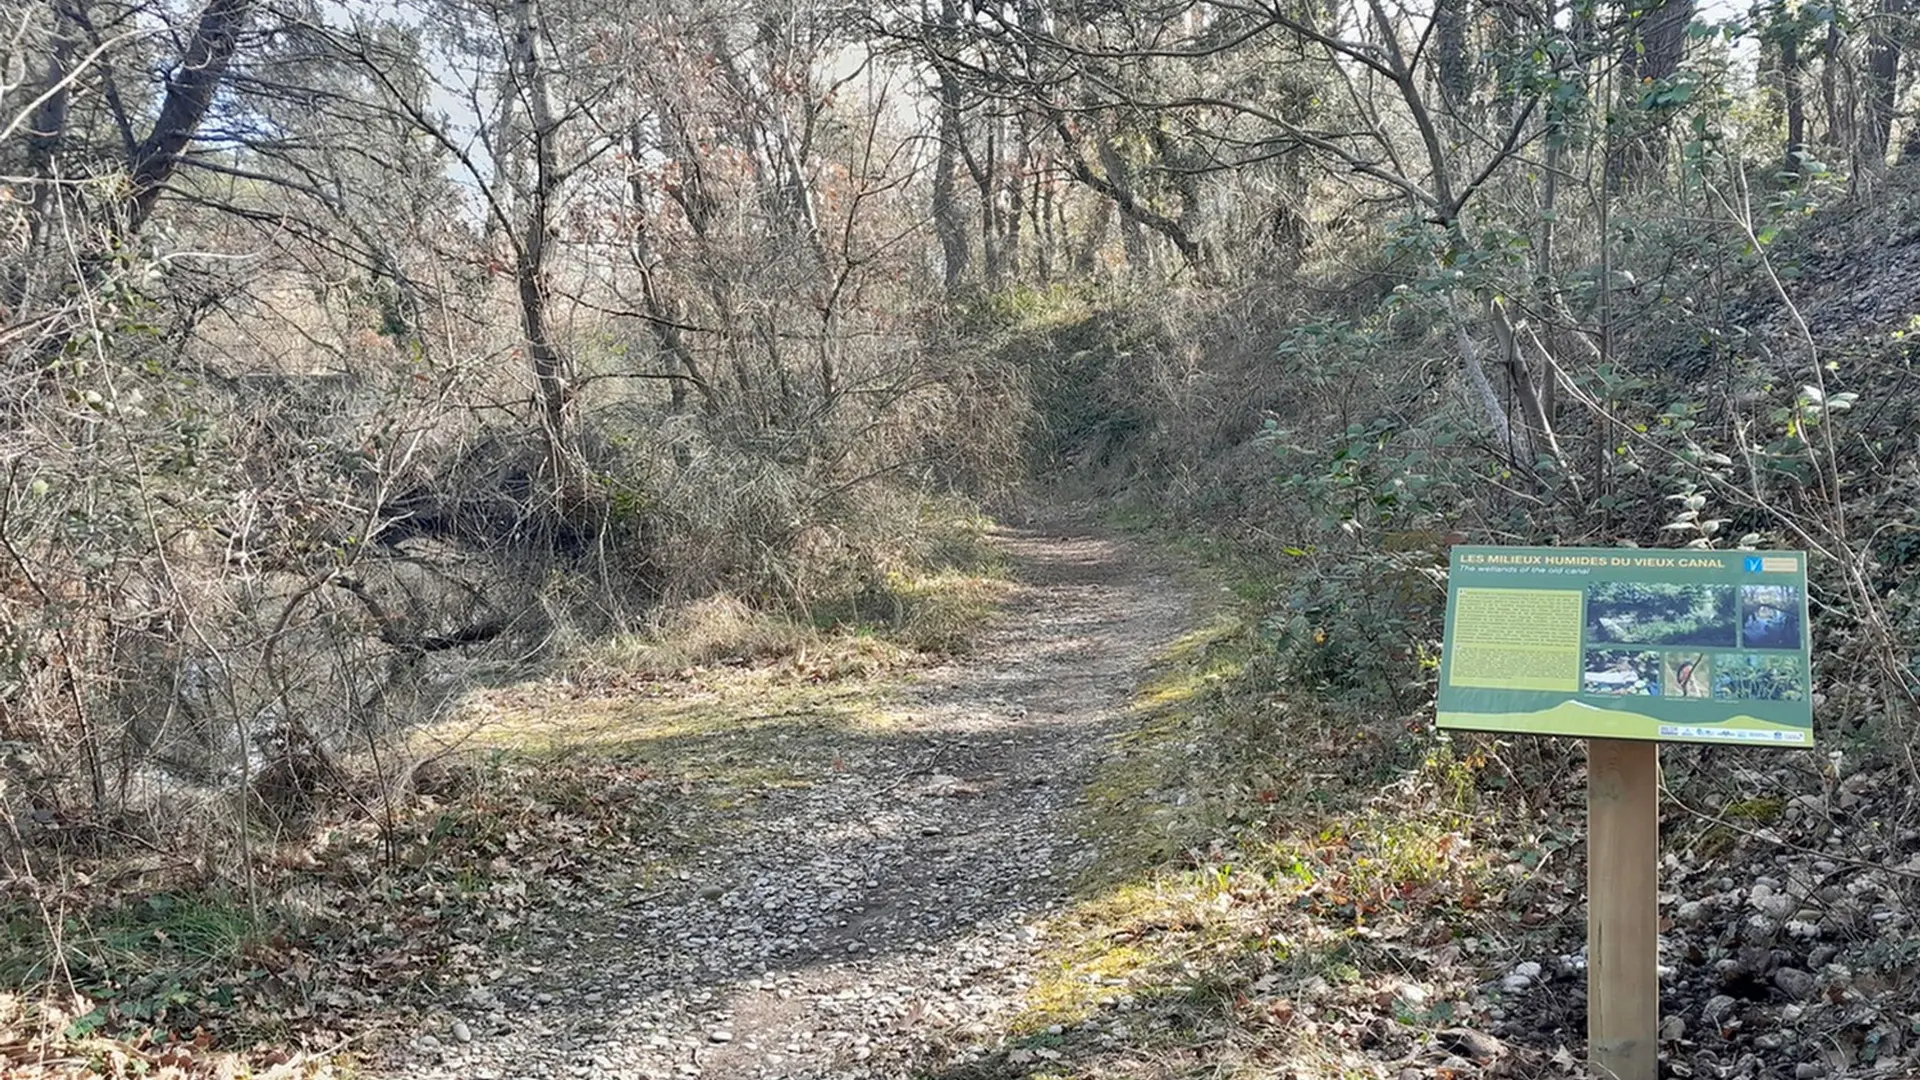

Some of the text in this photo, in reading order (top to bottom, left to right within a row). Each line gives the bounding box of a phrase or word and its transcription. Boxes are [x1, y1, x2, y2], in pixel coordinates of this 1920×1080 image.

[1460, 554, 1726, 569] LES MILIEUX HUMIDES DU VIEUX CANAL
[1478, 565, 1518, 573] wetlands
[1565, 567, 1591, 575] canal
